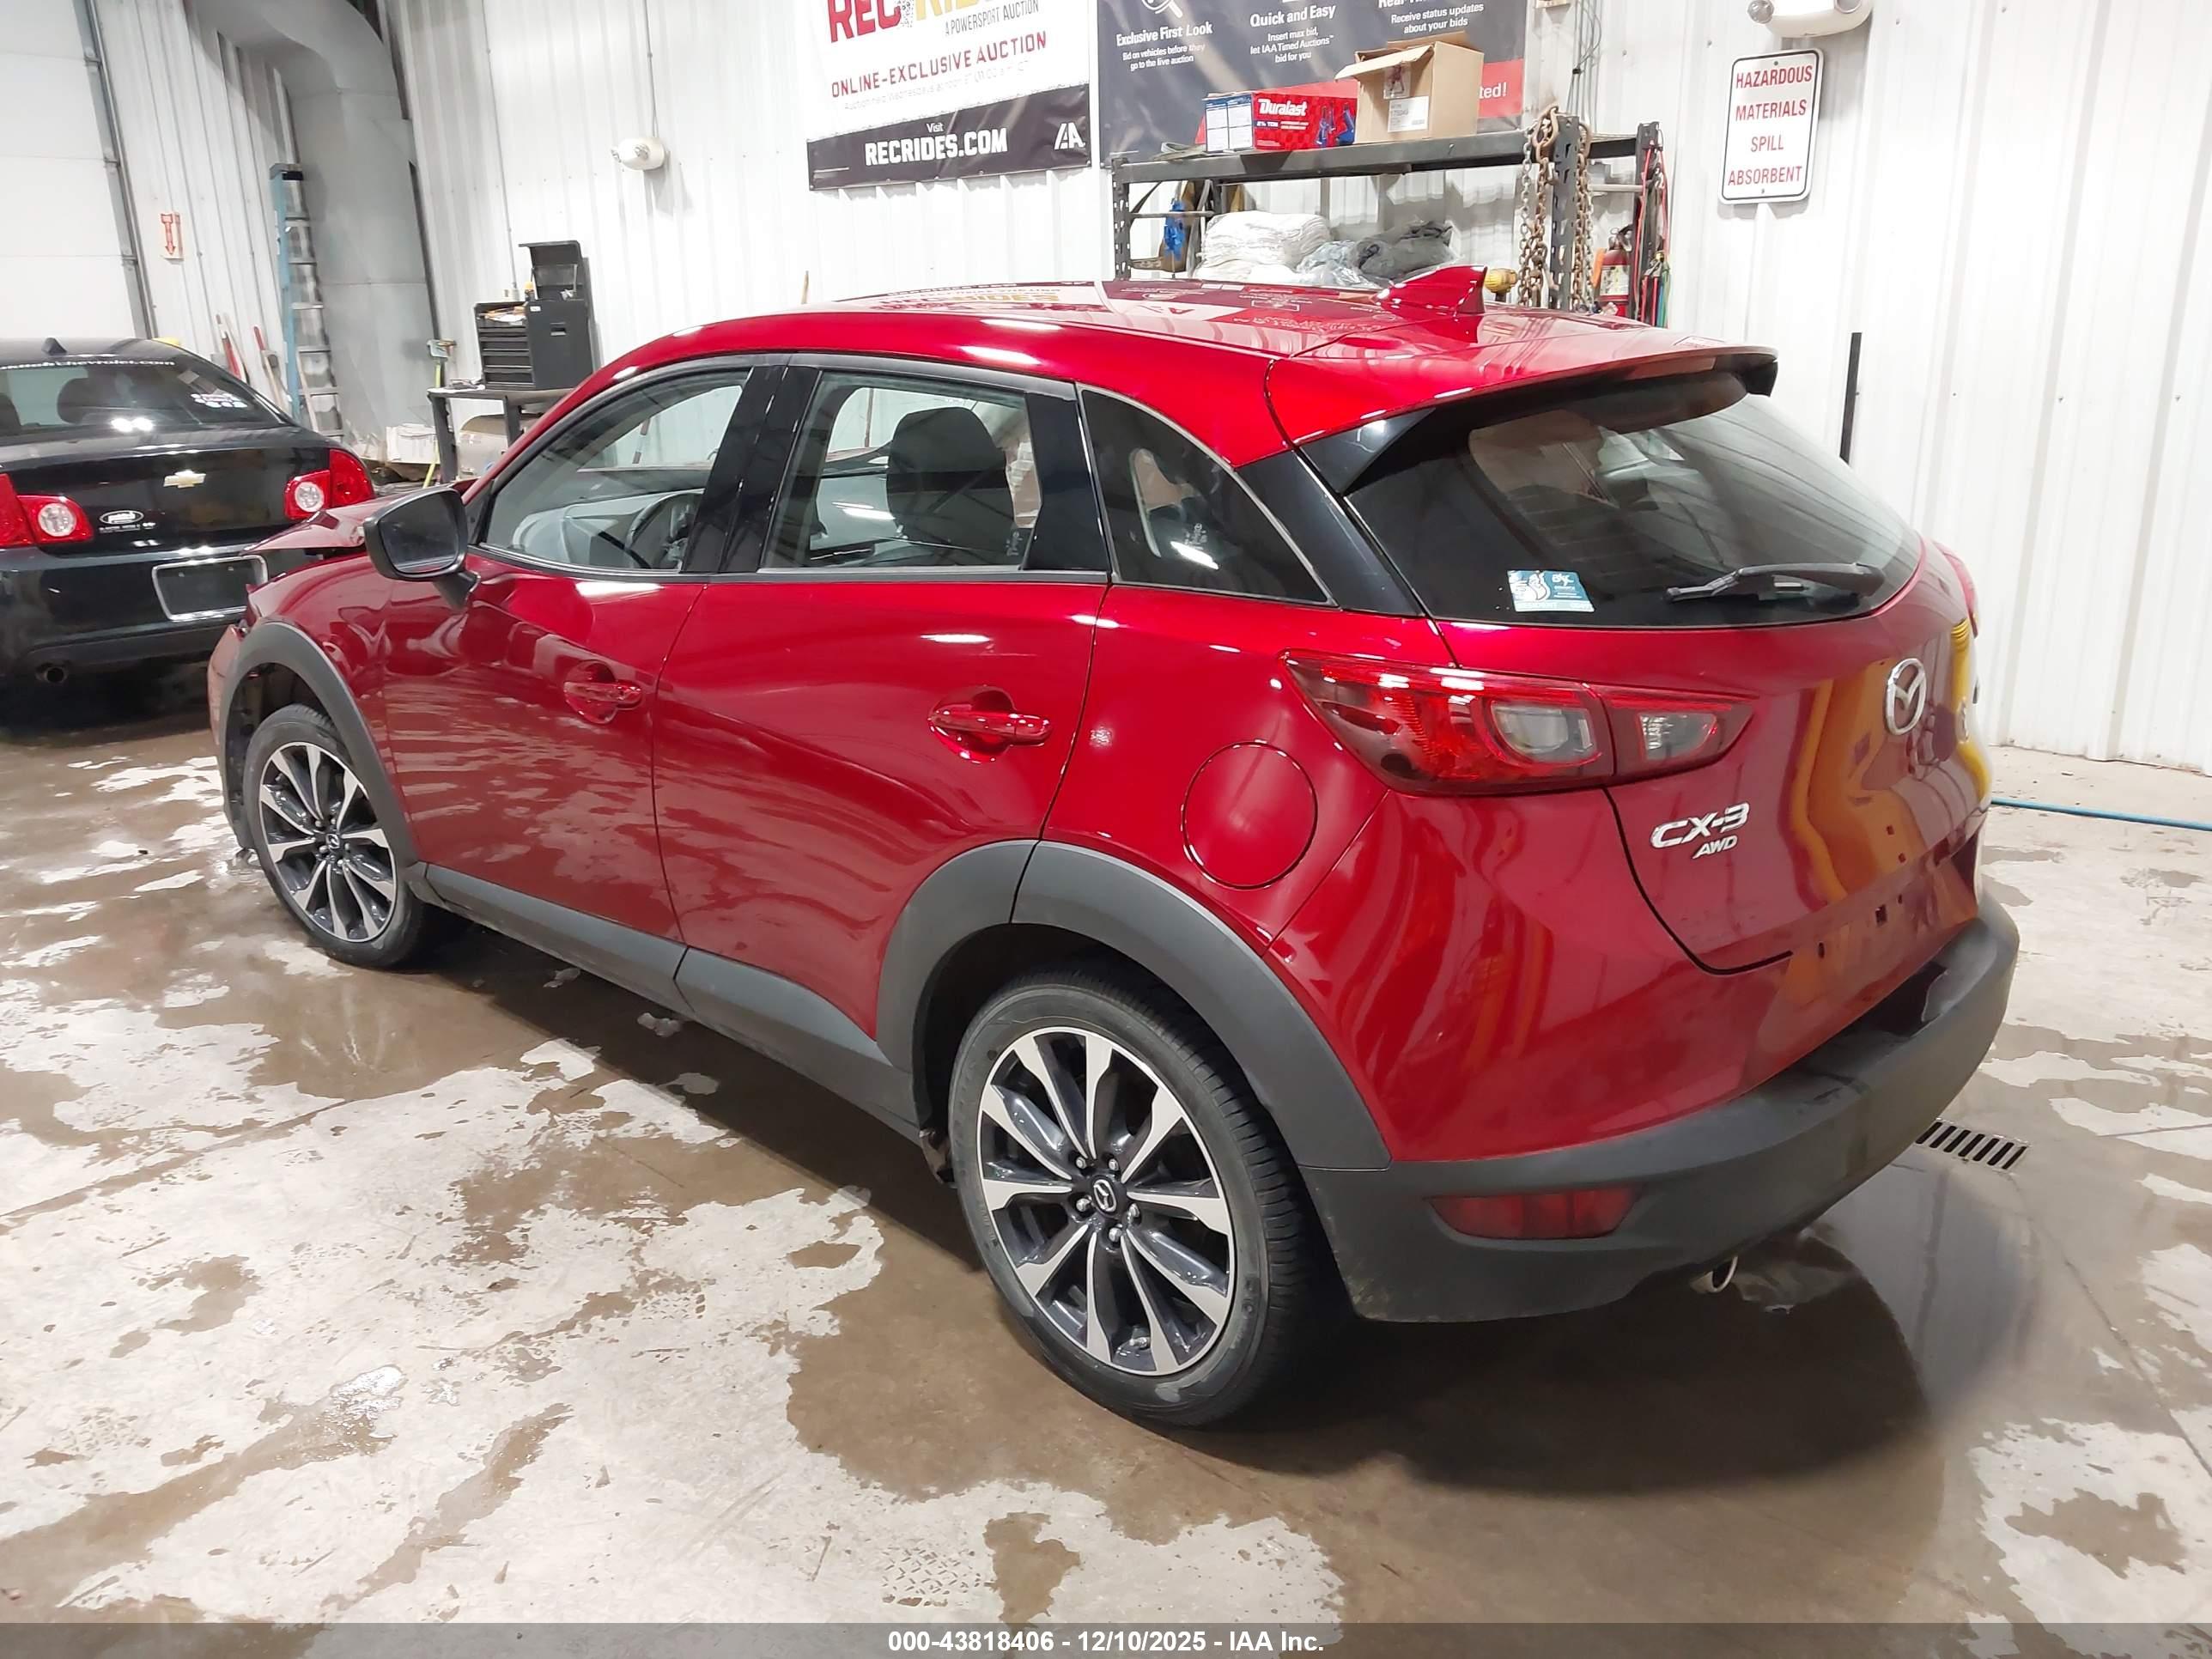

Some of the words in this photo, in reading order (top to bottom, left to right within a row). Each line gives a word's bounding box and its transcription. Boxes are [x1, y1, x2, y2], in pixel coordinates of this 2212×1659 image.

[951, 7, 1000, 34] POWERSPORT
[1003, 0, 1039, 21] AUCTION
[1249, 10, 1285, 27] Quick
[1286, 6, 1308, 23] and
[1310, 4, 1336, 19] Easy
[1391, 11, 1421, 24] Receive
[1422, 9, 1448, 19] status
[1449, 3, 1485, 16] updates
[1116, 29, 1158, 46] Exclusive
[1159, 26, 1183, 40] First
[1186, 21, 1213, 36] Look
[1267, 32, 1289, 41] Insert
[1290, 30, 1305, 39] max
[1305, 26, 1319, 36] bid,
[1404, 22, 1427, 33] about
[1427, 20, 1448, 32] your
[1449, 17, 1468, 27] bids
[1140, 48, 1167, 58] vehicles
[1167, 45, 1188, 54] before
[1249, 46, 1261, 55] let
[1261, 44, 1277, 53] IAA
[1277, 40, 1299, 52] Timed
[1274, 53, 1287, 63] bid
[1287, 52, 1297, 62] for
[1298, 52, 1312, 61] you
[831, 50, 972, 97] ONLINE-EXCLUSIVE
[975, 31, 1047, 64] AUCTION
[1130, 63, 1139, 71] go
[1157, 58, 1170, 66] live
[1170, 55, 1194, 64] auction
[1736, 65, 1813, 88] HAZARDOUS
[1257, 98, 1308, 117] Duralast
[1735, 99, 1807, 122] MATERIALS
[926, 122, 944, 134] Visit
[865, 128, 1008, 166] RECRIDES.COM
[1751, 135, 1784, 152] SPILL
[1728, 166, 1802, 185] ABSORBENT
[1650, 803, 1750, 848] CX-3
[1692, 836, 1738, 859] AWD
